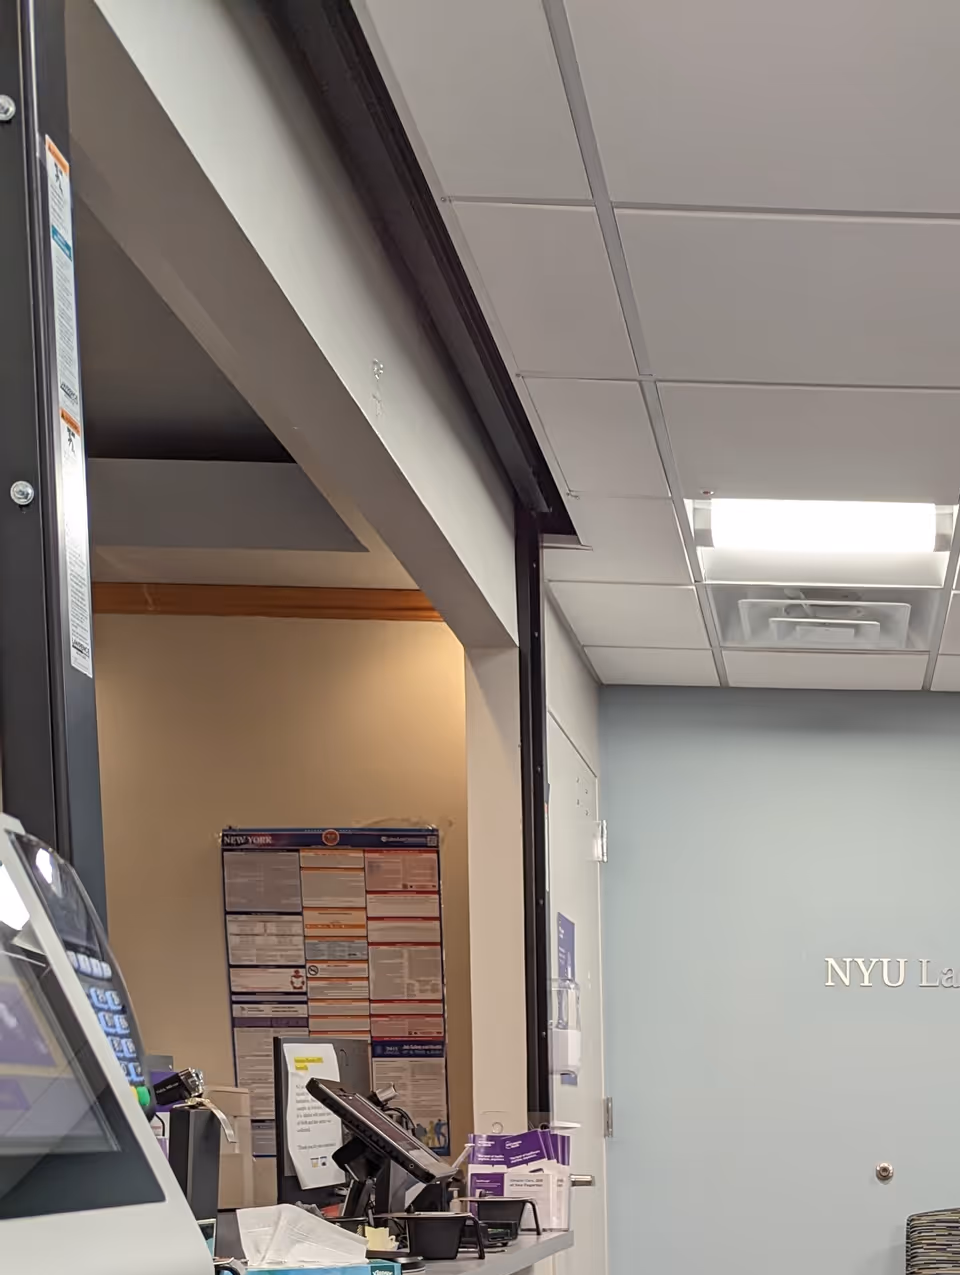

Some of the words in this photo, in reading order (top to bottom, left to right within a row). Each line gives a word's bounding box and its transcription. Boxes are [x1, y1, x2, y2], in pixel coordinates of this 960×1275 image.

[223, 835, 246, 845] NEW
[247, 835, 273, 845] YORK
[824, 957, 908, 988] NYU
